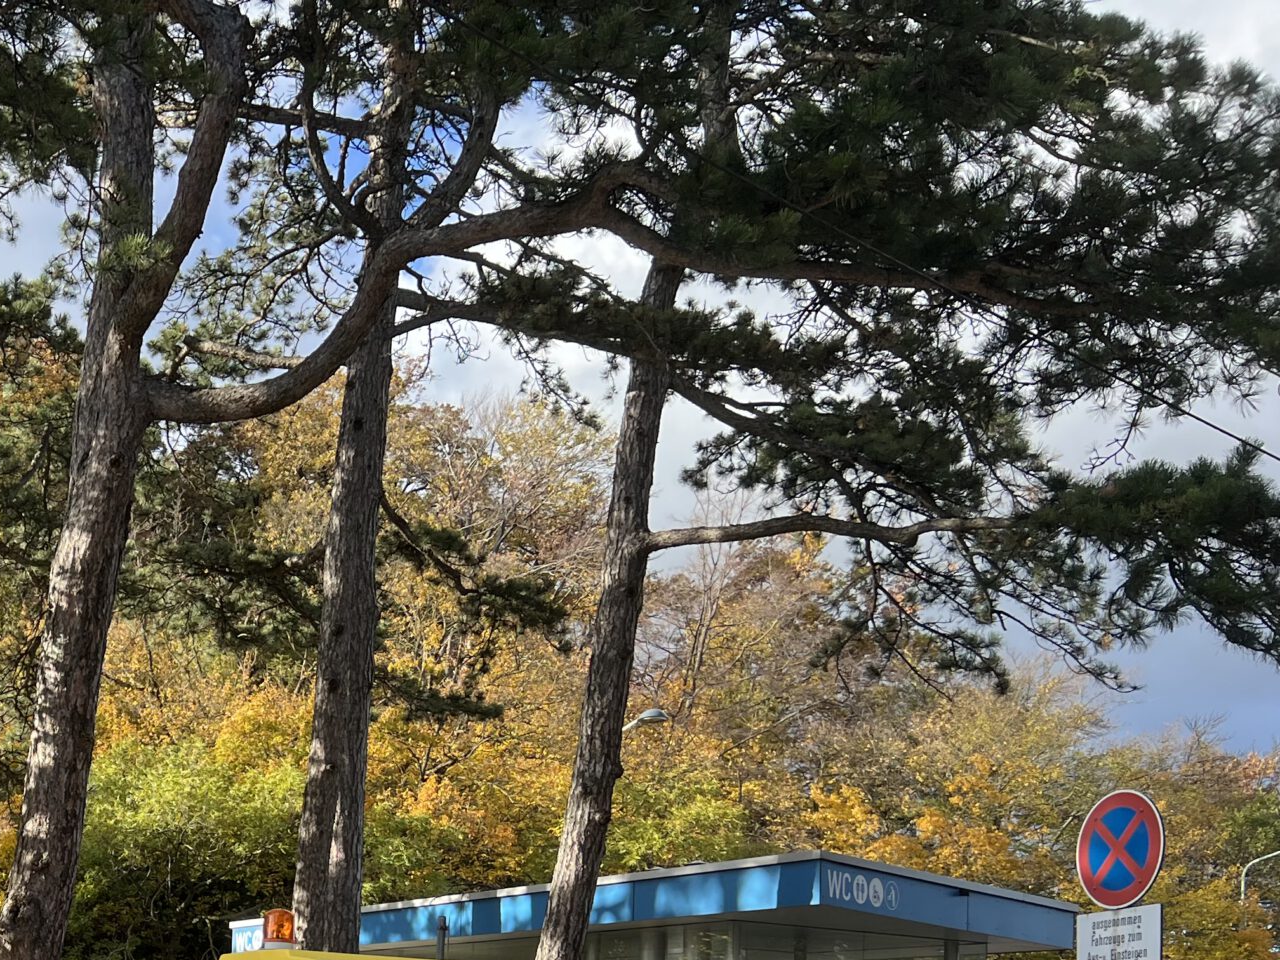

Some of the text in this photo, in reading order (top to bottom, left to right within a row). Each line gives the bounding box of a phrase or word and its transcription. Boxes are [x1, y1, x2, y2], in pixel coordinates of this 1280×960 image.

[828, 869, 851, 901] WC
[1092, 915, 1142, 931] ausgenommen
[235, 931, 252, 953] WC
[1091, 932, 1142, 947] Fahrzeuge zum
